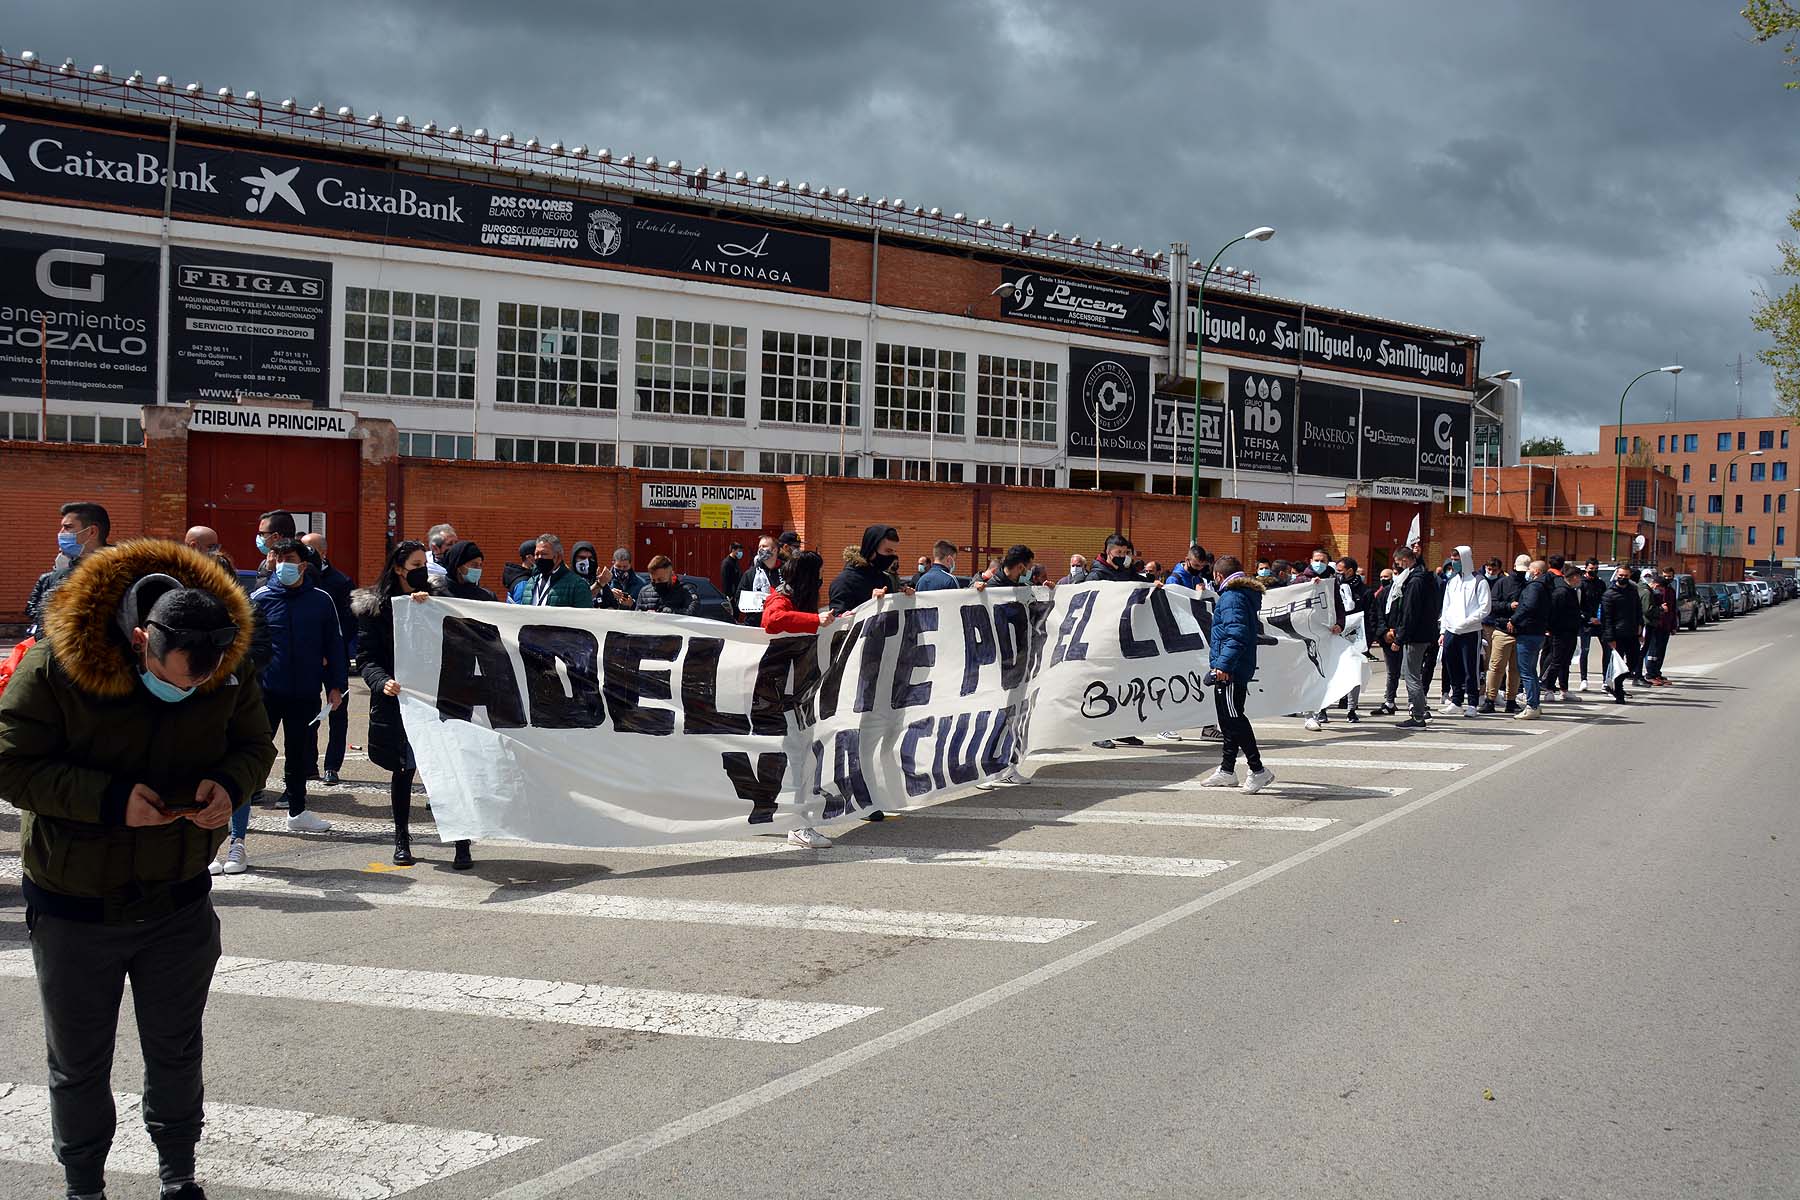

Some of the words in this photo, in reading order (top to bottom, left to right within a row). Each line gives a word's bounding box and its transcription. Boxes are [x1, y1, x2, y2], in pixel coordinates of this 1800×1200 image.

[28, 138, 219, 194] CaixaBank
[316, 177, 464, 223] CaixaBank
[490, 195, 517, 208] DOS
[518, 198, 573, 212] COLORES
[489, 207, 525, 218] BLANCO
[531, 210, 537, 219] Y
[542, 211, 572, 221] NEGRO
[480, 232, 499, 245] UN
[500, 234, 579, 249] SENTIMIENTO
[691, 258, 792, 284] ANTONAGA
[183, 269, 319, 296] FRIGAS
[178, 295, 220, 305] MAQUINARIA
[277, 304, 324, 314] ALIMENTACIÓN
[1045, 284, 1128, 313] Rycam
[202, 305, 240, 314] INDUSTRIAL
[247, 308, 262, 316] AIRE
[263, 310, 317, 321] ACONDICIONADO
[1068, 311, 1106, 323] ASCENSORES
[192, 321, 234, 332] SERVICIO
[276, 327, 309, 338] PROPIO
[1248, 327, 1266, 345] 0,0
[1357, 345, 1372, 363] 0,0
[50, 359, 98, 369] materiales
[99, 362, 112, 370] de
[113, 364, 148, 372] calidad
[1450, 362, 1464, 377] 0,0
[193, 409, 262, 428] TRIBUNA
[267, 413, 346, 433] PRINCIPAL
[1154, 398, 1221, 440] FABRI
[1244, 401, 1282, 434] nb
[1303, 421, 1355, 445] BRASEROS
[1243, 436, 1280, 451] TEFISA
[648, 484, 698, 500] TRIBUNA
[701, 486, 757, 501] PRINCIPAL
[1376, 484, 1400, 496] TRIBUNA
[1401, 486, 1430, 498] PRINCIPAL
[1277, 513, 1309, 524] PRINCIPAL
[1049, 589, 1100, 668] EL
[1080, 670, 1206, 723] BURGOS
[720, 751, 788, 825] Y
